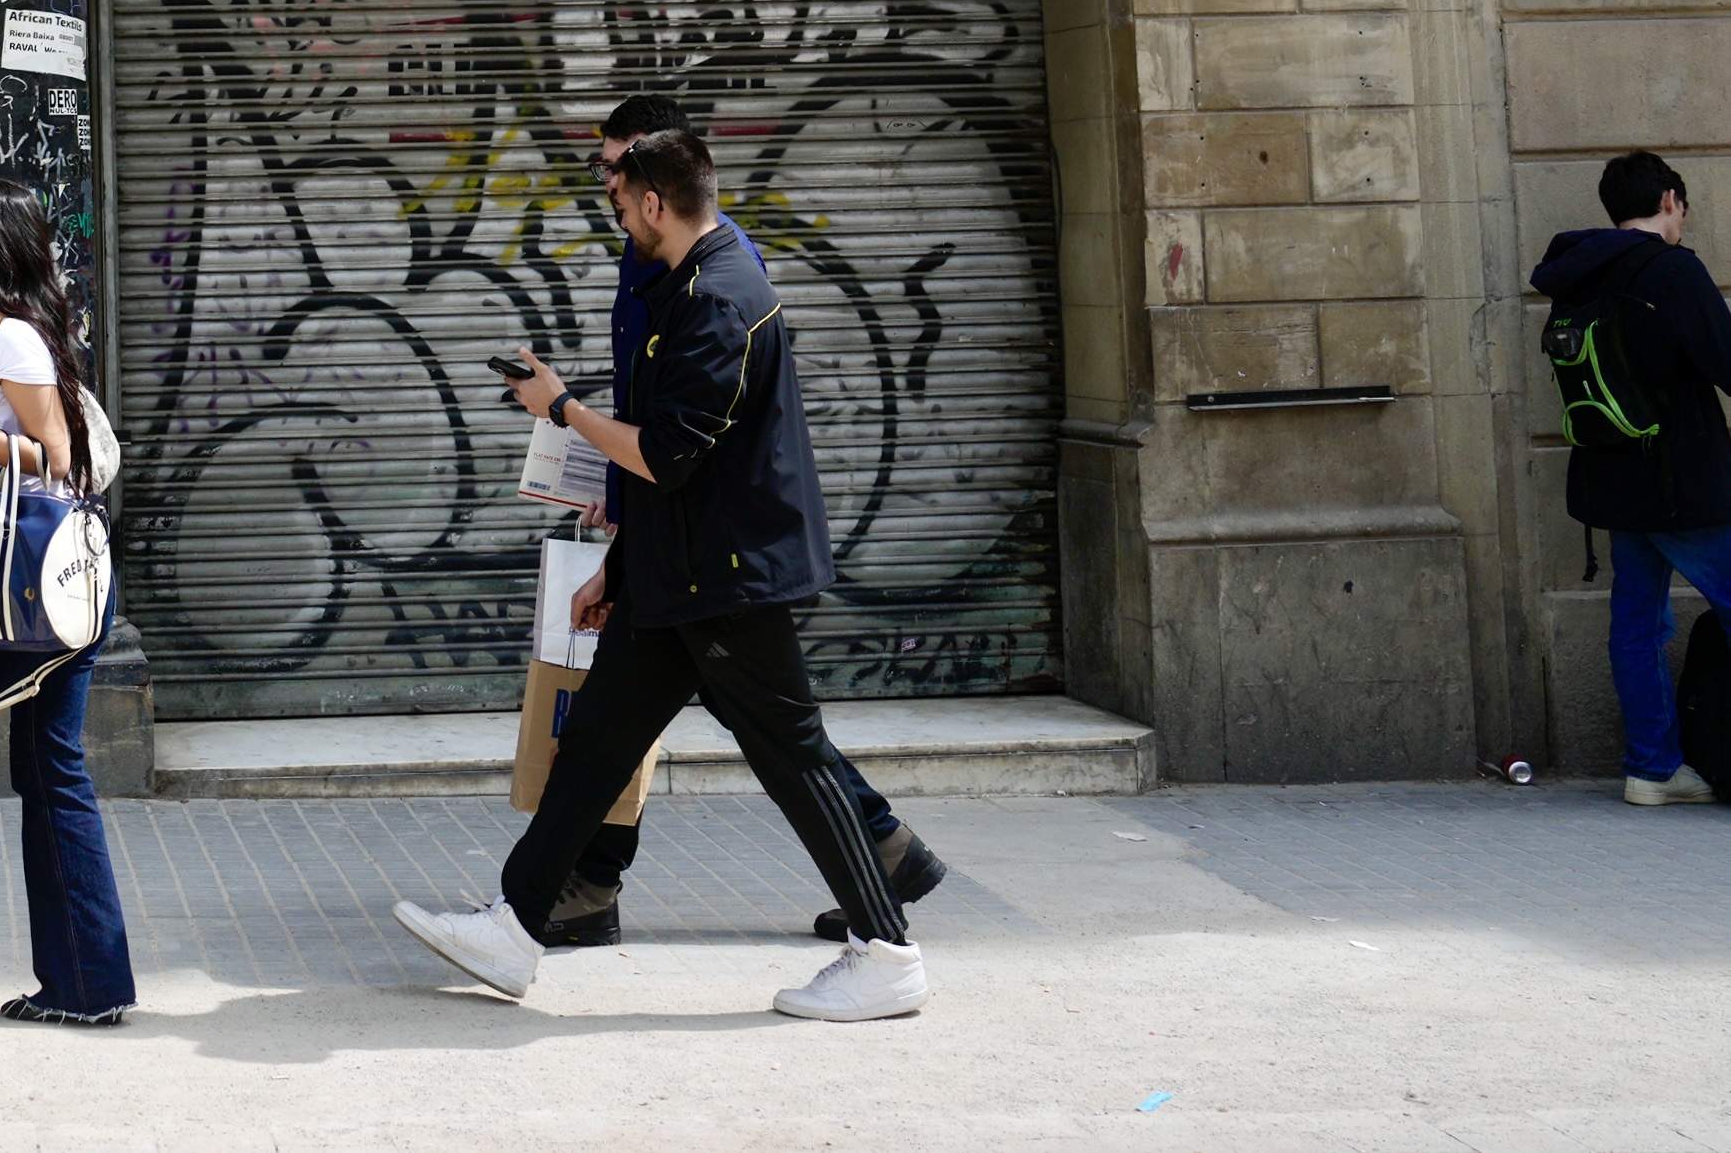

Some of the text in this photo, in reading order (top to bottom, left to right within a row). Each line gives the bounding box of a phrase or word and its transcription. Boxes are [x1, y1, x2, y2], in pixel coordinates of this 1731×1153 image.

[9, 11, 82, 32] African Textils
[9, 30, 31, 38] Riera
[33, 32, 55, 41] Baixa
[49, 90, 77, 108] DERO
[56, 558, 83, 588] FRED
